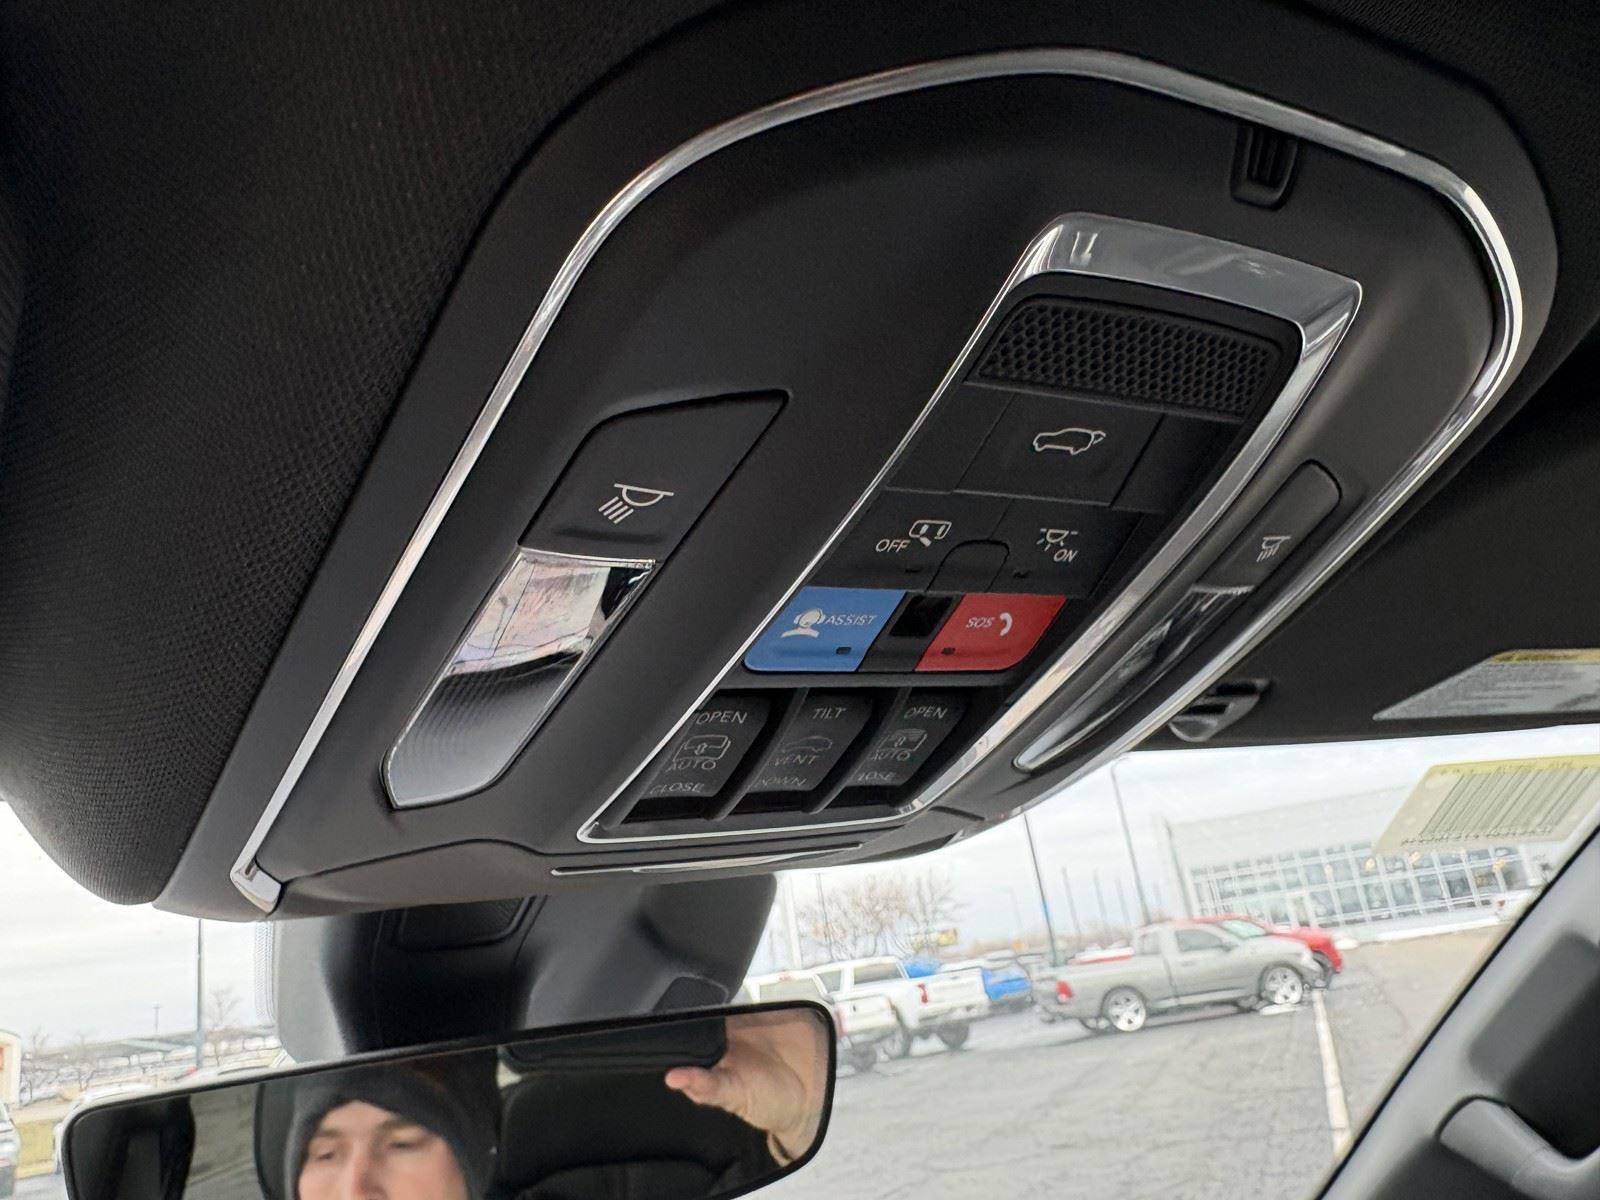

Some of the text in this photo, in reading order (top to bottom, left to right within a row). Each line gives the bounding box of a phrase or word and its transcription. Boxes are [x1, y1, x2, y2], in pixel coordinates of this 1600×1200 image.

[875, 539, 911, 552] OFF
[1053, 549, 1078, 562] ON
[824, 614, 877, 626] ASSIST
[966, 616, 996, 628] SOS
[696, 710, 748, 725] OPEN
[812, 707, 847, 719] TILT
[903, 706, 948, 719] OPEN
[664, 758, 717, 772] AUTO
